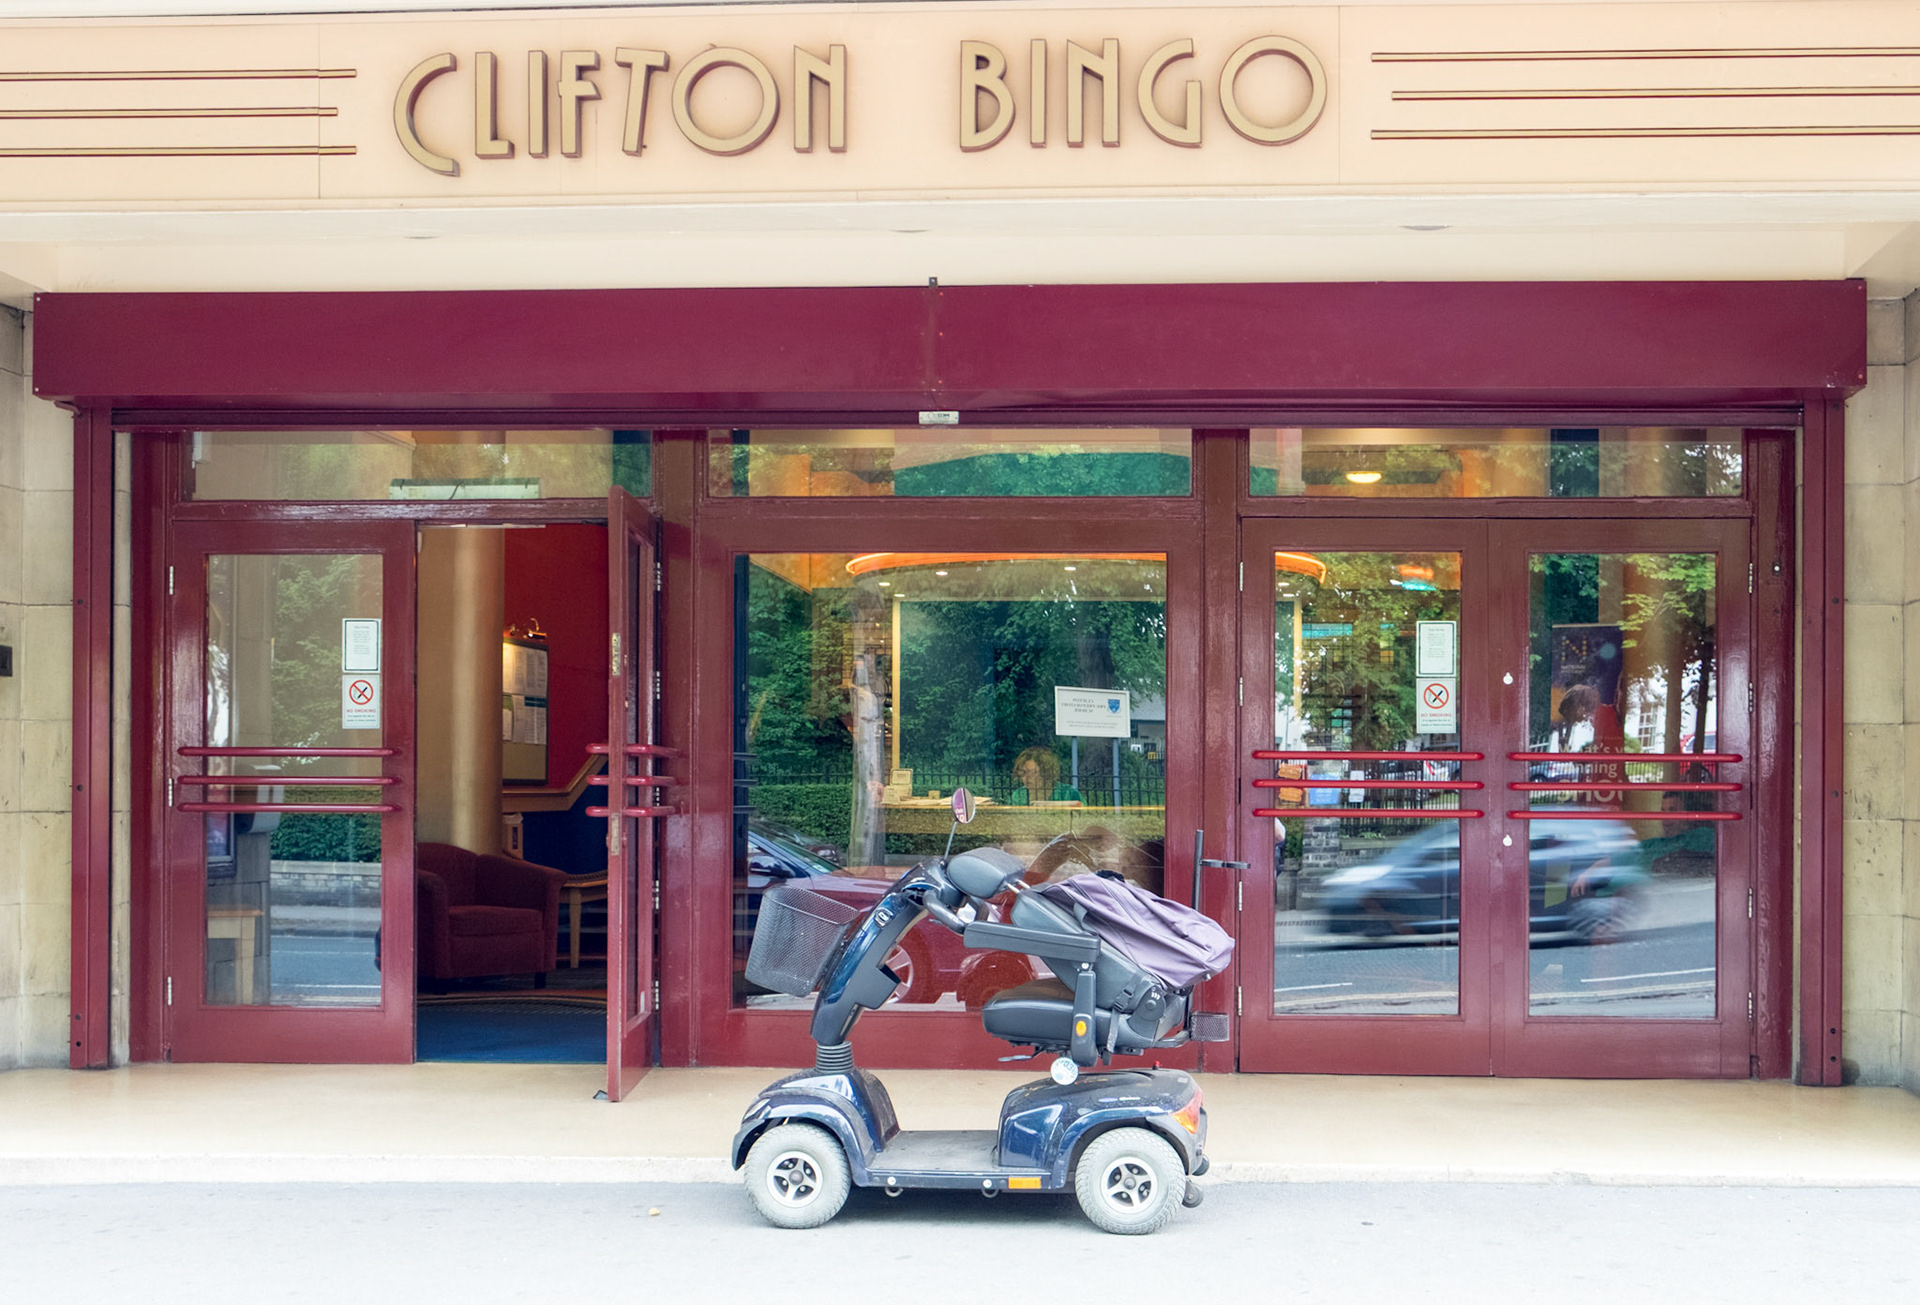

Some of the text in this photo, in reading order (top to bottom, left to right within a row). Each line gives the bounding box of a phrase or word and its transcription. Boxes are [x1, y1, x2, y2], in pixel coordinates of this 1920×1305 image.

[393, 35, 1328, 177] CLIFTON BINGO
[1559, 742, 1611, 753] Wat's
[1562, 761, 1618, 778] nning
